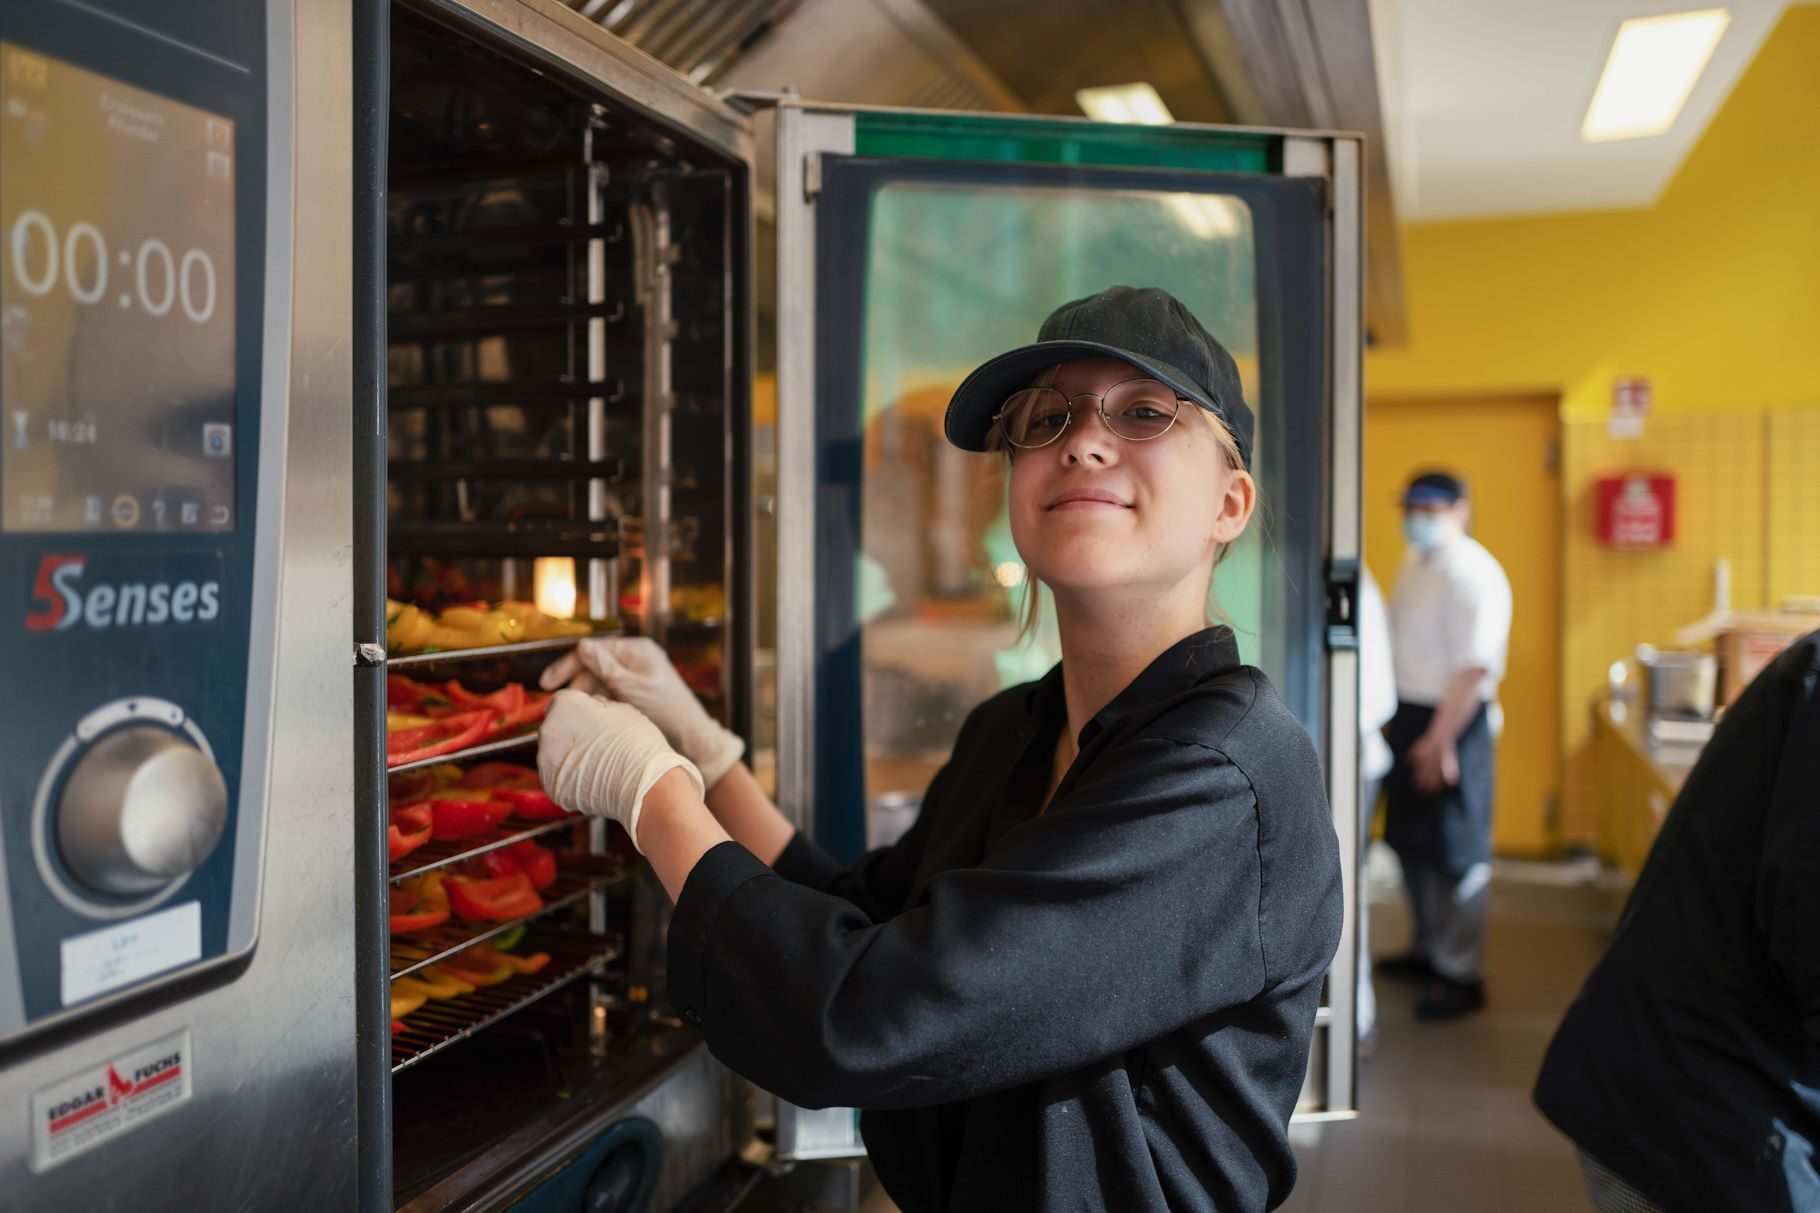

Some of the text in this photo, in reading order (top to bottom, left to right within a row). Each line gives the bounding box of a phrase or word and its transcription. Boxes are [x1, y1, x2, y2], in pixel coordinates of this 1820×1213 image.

[11, 209, 217, 323] 00:00
[49, 1086, 104, 1121] EDGAR
[134, 1051, 181, 1082] FUCHS
